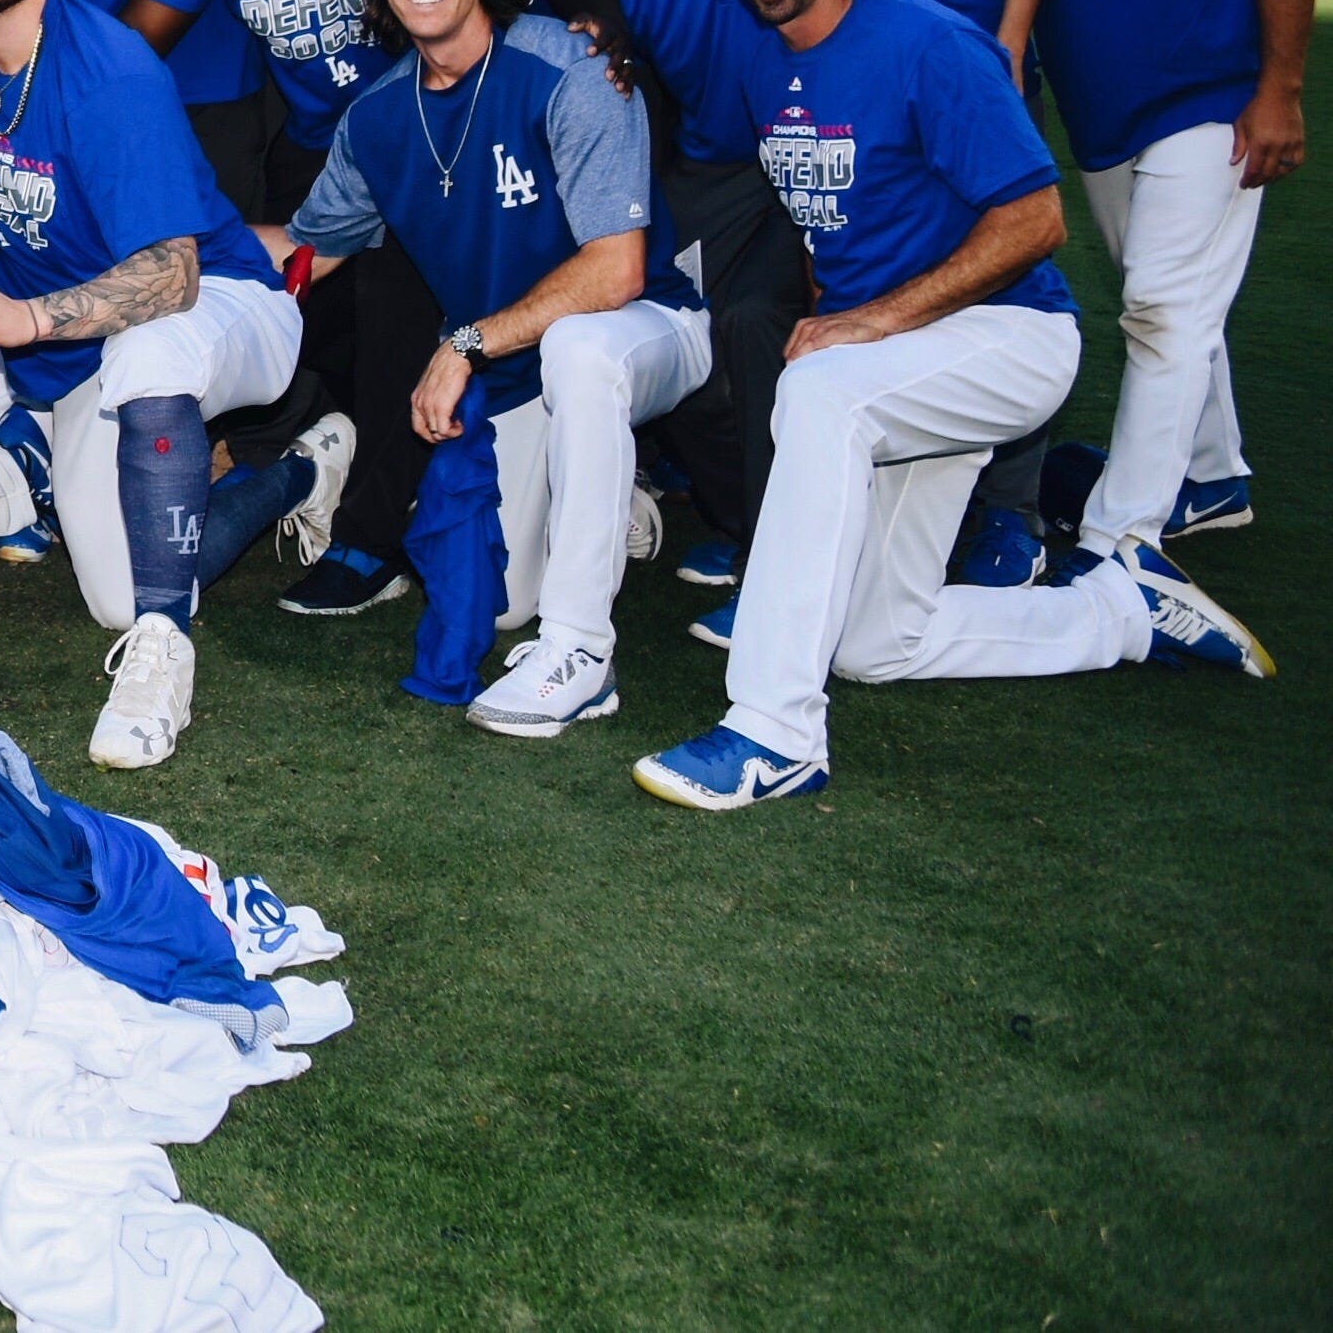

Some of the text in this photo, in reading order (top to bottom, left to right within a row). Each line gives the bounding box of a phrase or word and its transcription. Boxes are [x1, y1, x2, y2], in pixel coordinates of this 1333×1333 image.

[268, 31, 317, 60] SO
[326, 55, 359, 88] LA
[492, 143, 539, 209] LA
[790, 192, 849, 229] CAL
[166, 505, 201, 556] LA
